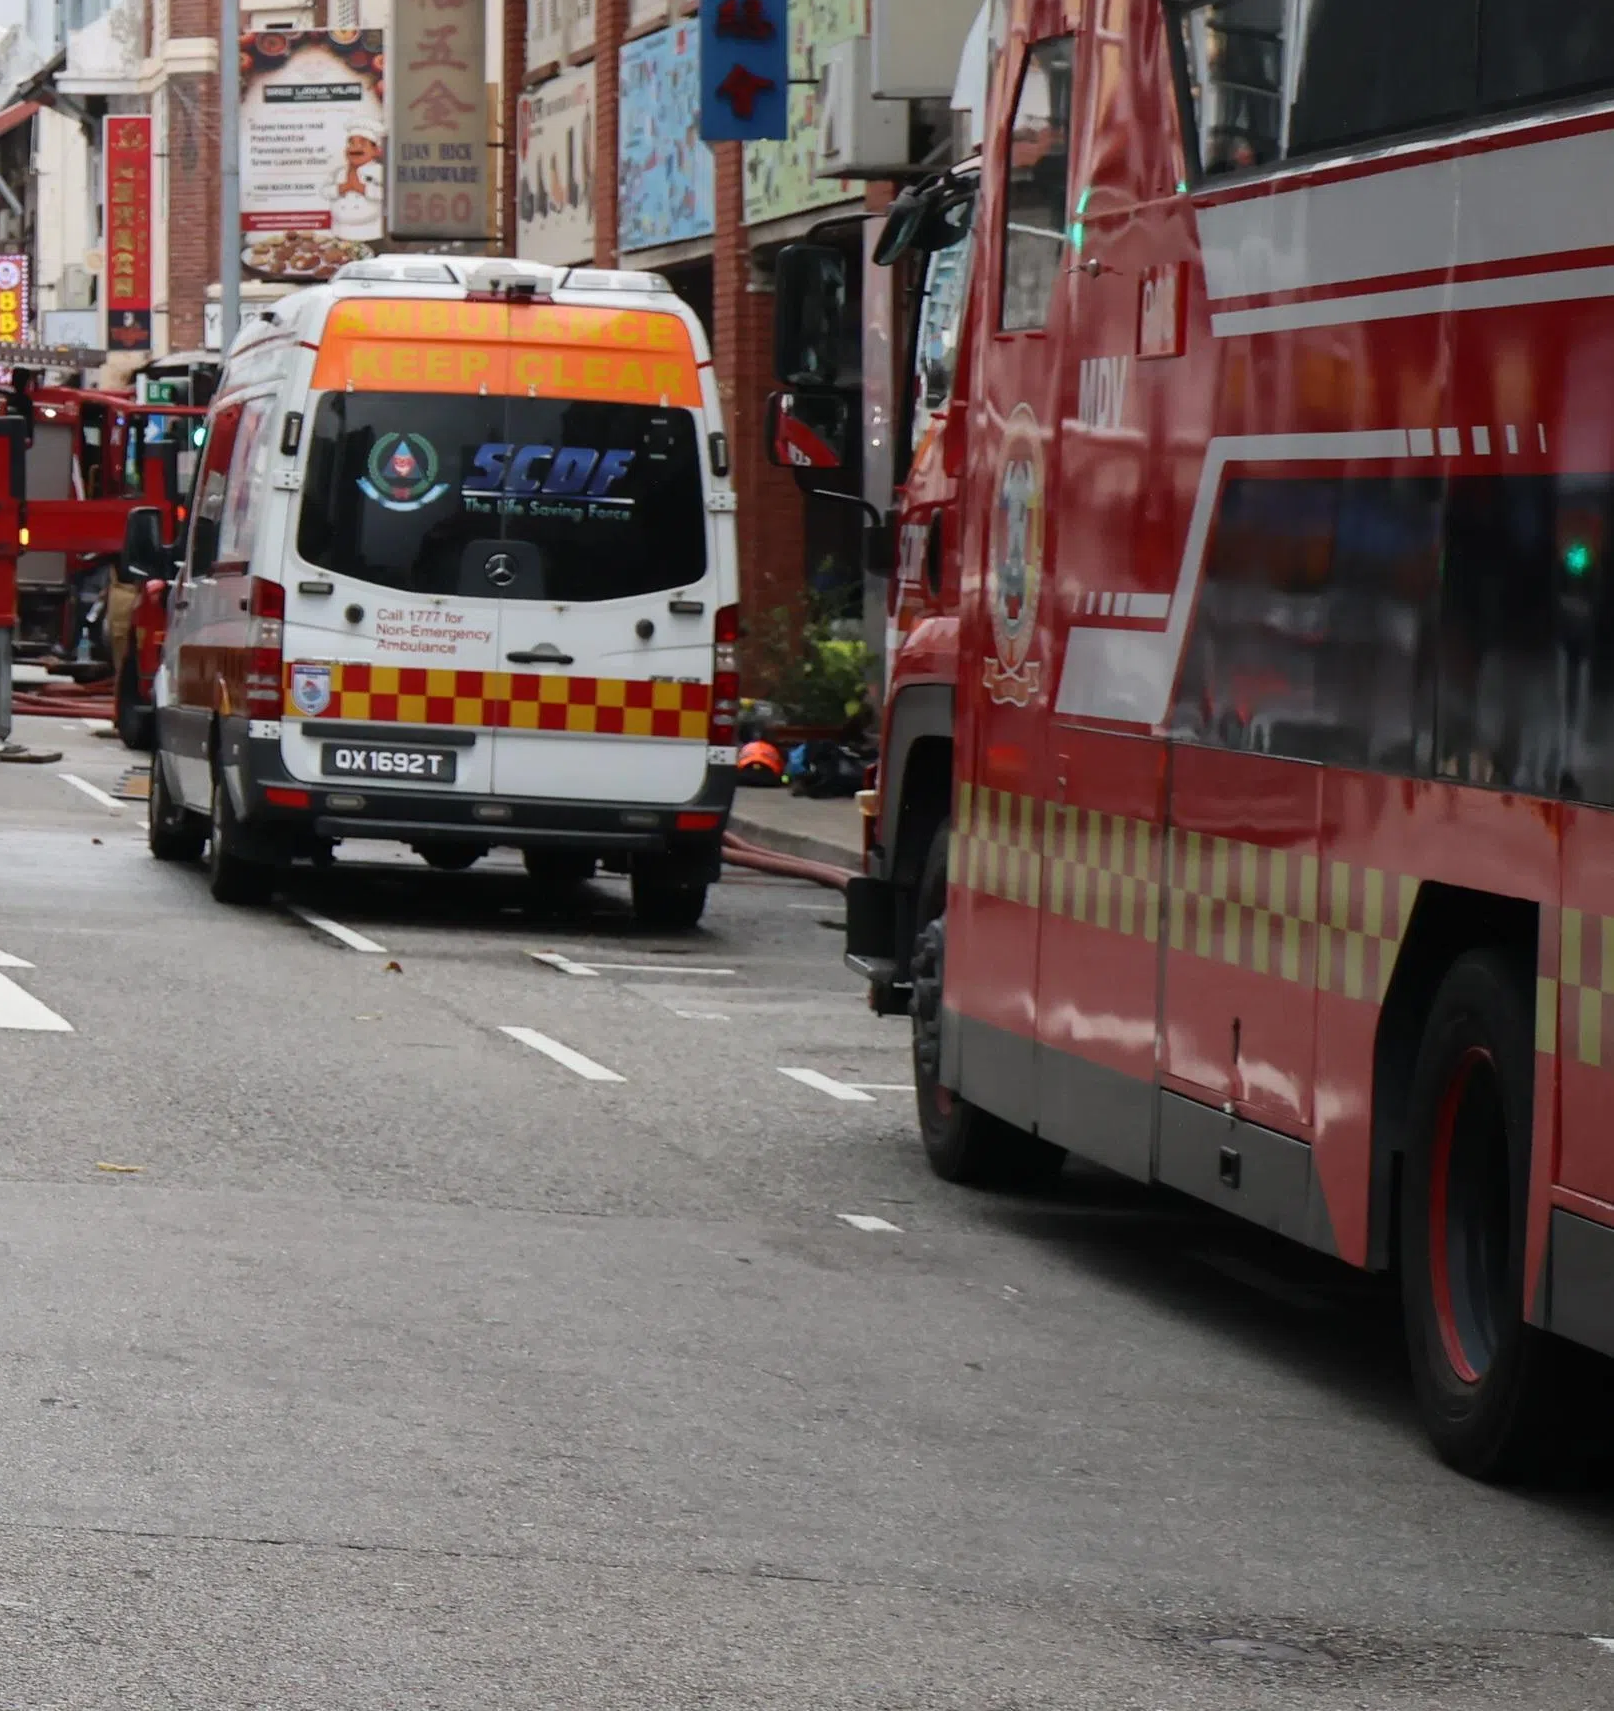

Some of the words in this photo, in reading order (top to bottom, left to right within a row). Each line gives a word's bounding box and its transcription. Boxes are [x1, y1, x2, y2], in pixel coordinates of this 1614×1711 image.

[399, 191, 473, 224] 560
[334, 302, 676, 350] AMBULANCE
[350, 348, 490, 383] KEEP
[515, 354, 684, 395] CLEAR
[462, 443, 637, 495] SCDF
[463, 498, 492, 514] The
[496, 498, 524, 516] Life
[529, 499, 584, 522] Saving
[588, 503, 632, 521] Force
[376, 608, 404, 621] Call
[409, 610, 441, 623] 1777
[444, 611, 464, 624] for
[375, 623, 491, 643] Non-Emergency
[376, 639, 458, 654] Ambulance
